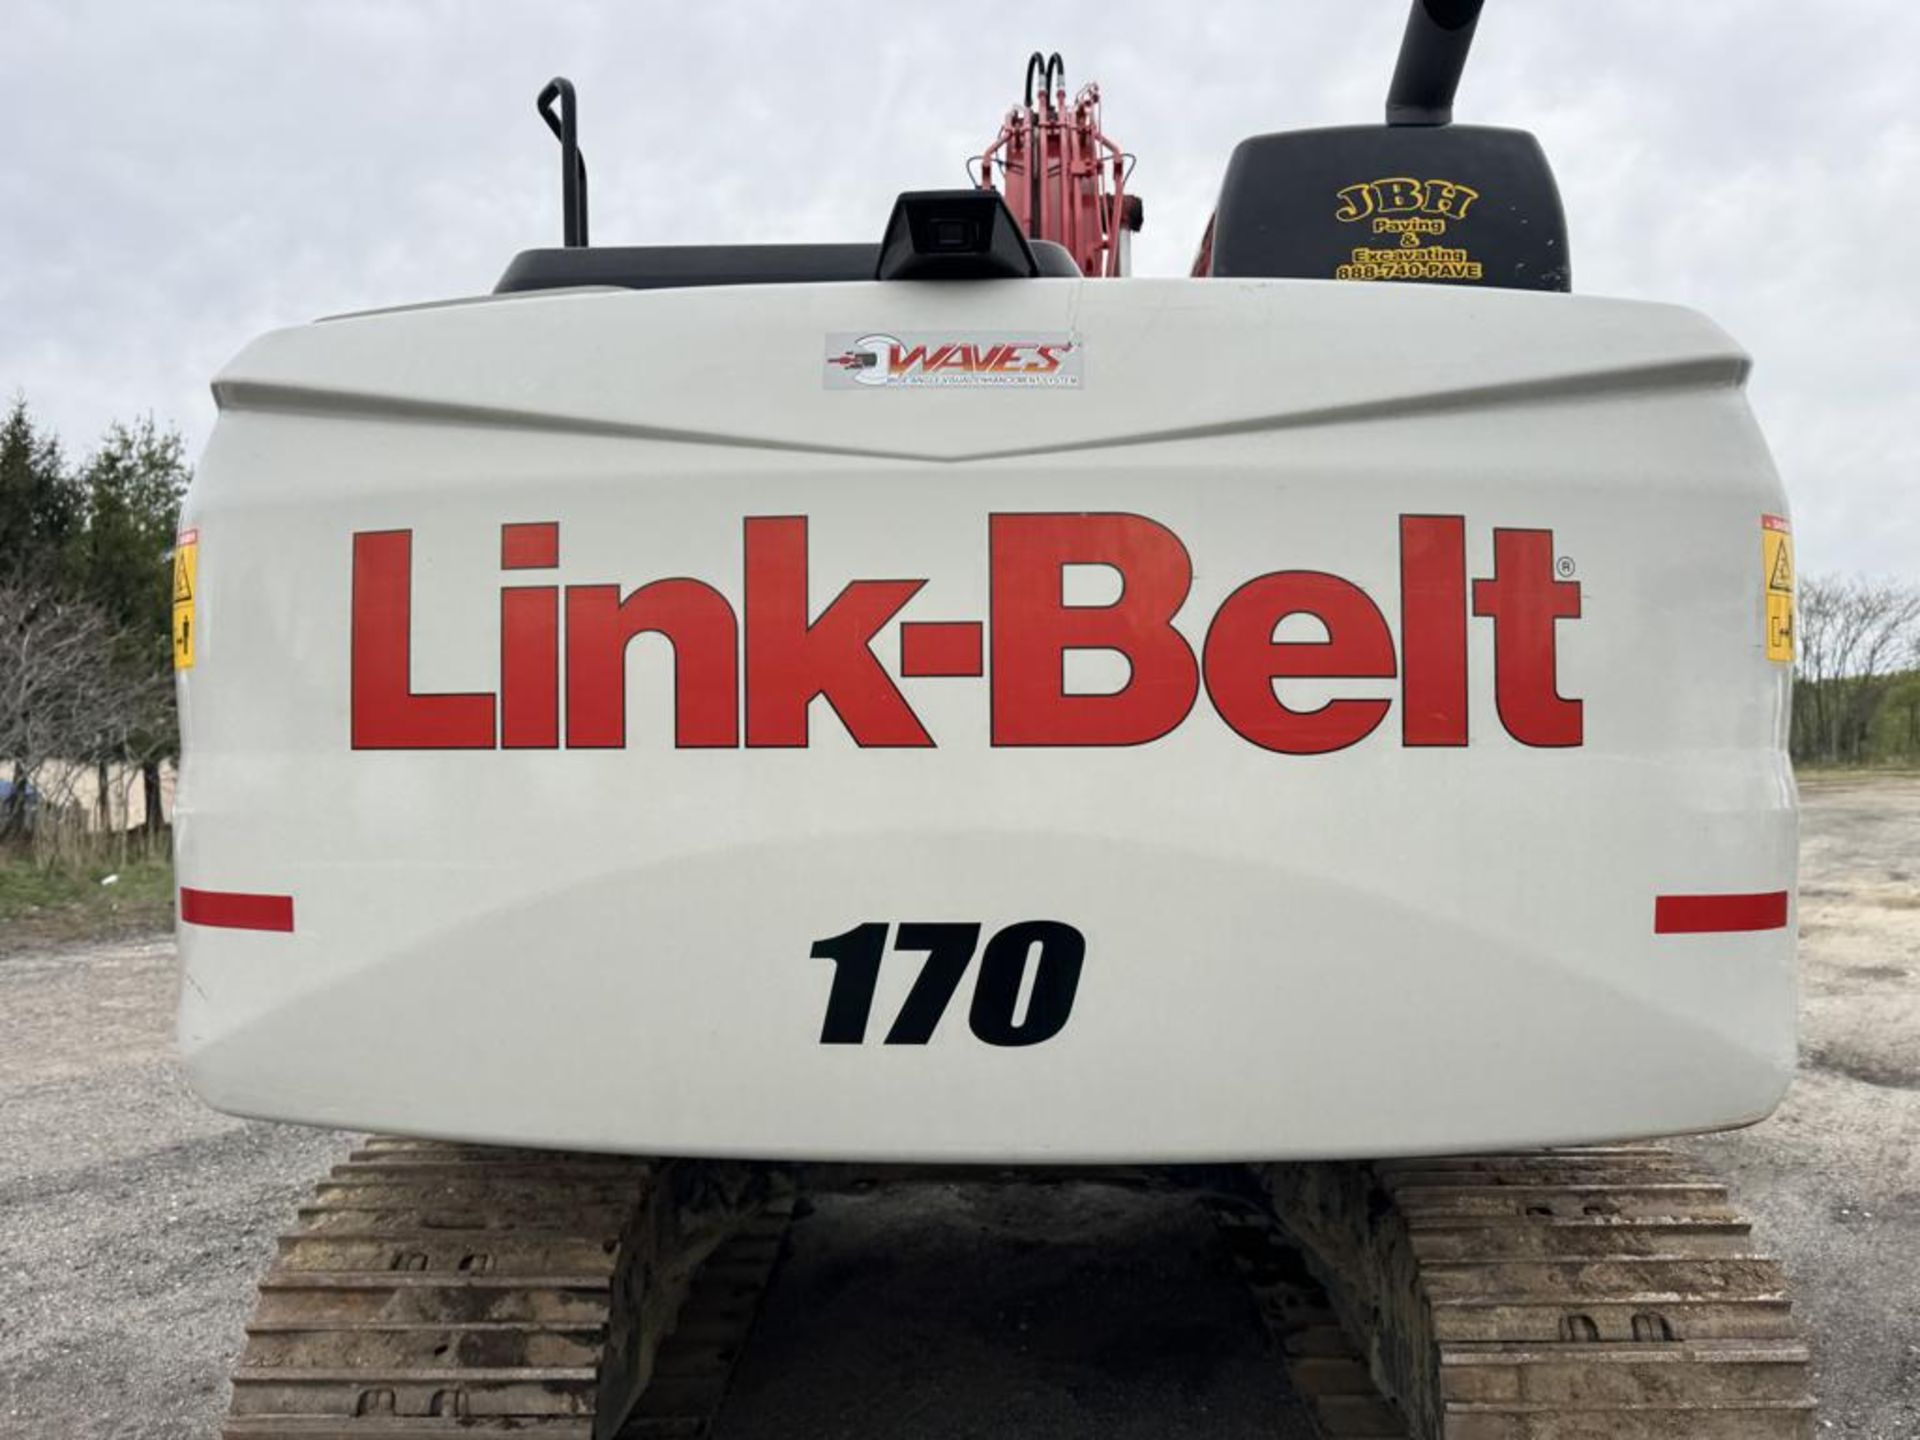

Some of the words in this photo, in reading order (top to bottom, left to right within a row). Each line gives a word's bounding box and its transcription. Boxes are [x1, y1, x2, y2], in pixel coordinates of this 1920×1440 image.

[1336, 178, 1479, 222] JBH
[1372, 217, 1446, 235] Paving
[1400, 232, 1420, 247] &
[1351, 246, 1468, 264] Excavating
[1337, 262, 1483, 281] 888-740-PAVE
[887, 343, 1070, 374] WAVES
[352, 512, 1584, 754] Link-Belt
[810, 919, 1086, 1047] 170
